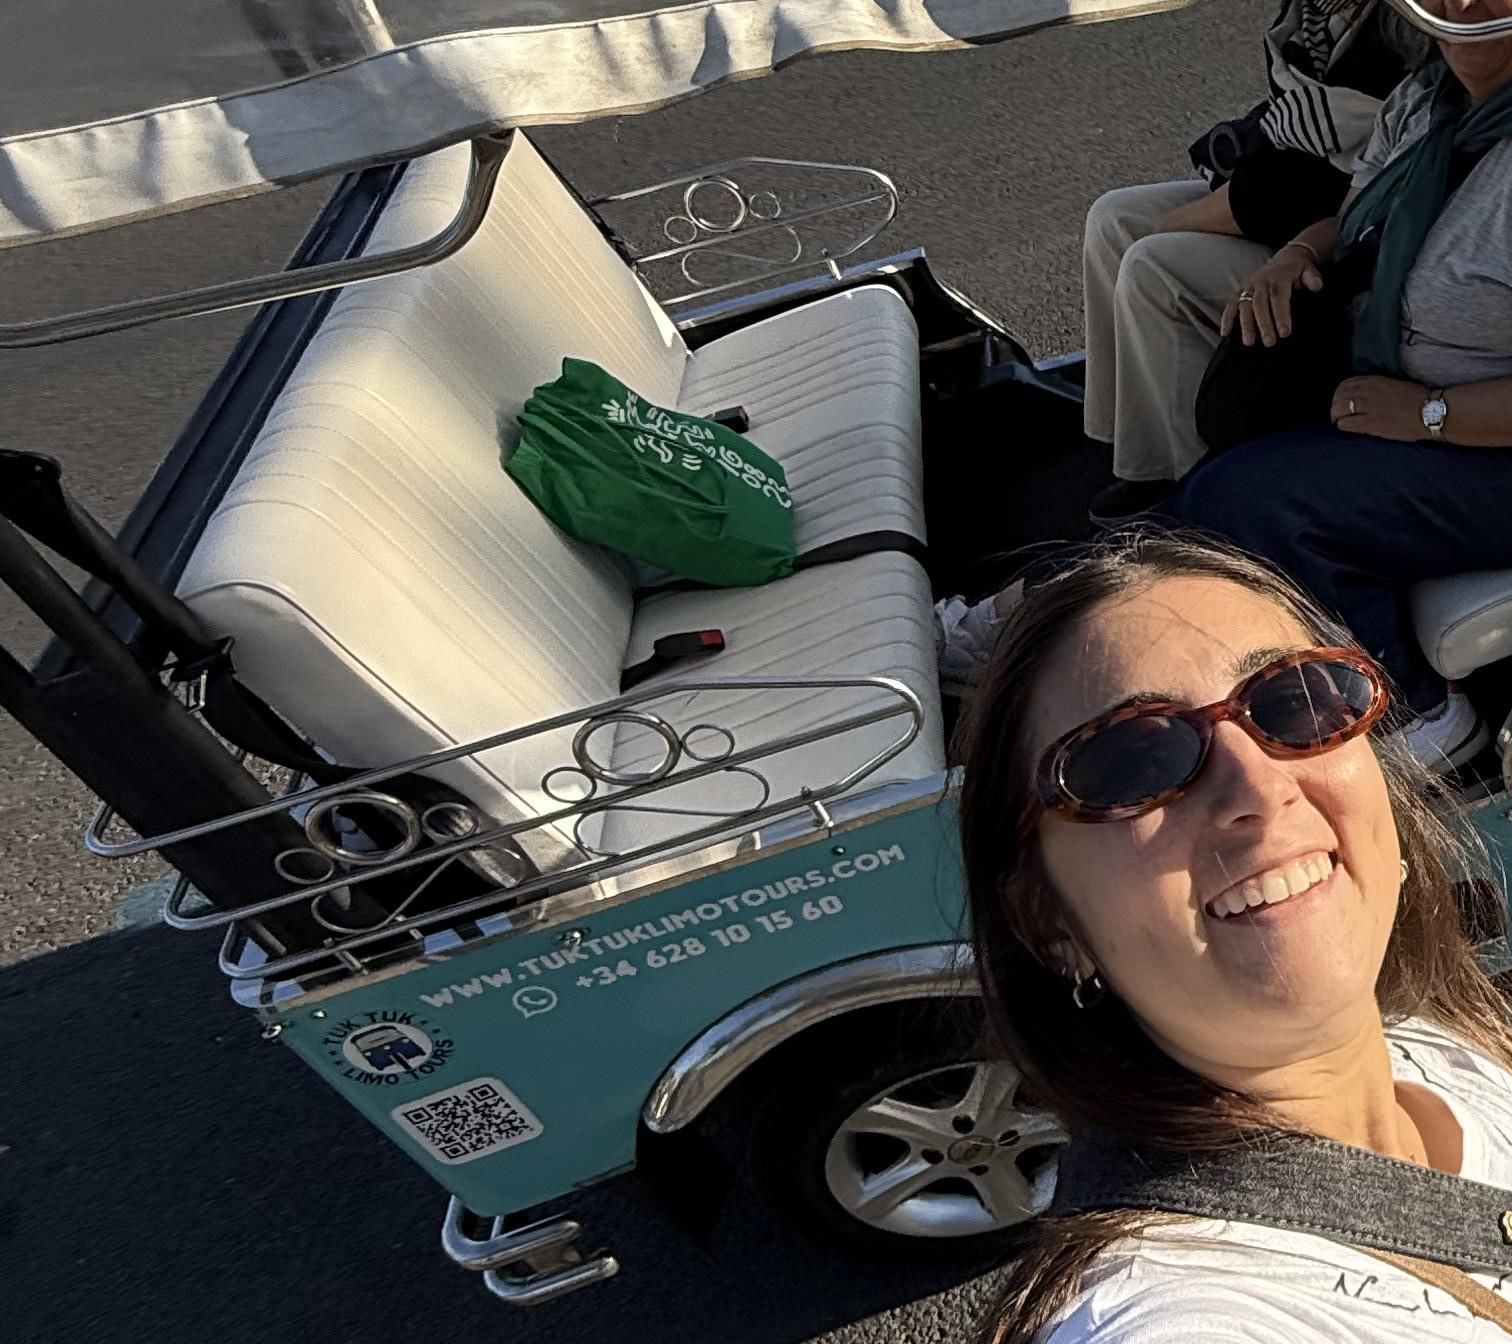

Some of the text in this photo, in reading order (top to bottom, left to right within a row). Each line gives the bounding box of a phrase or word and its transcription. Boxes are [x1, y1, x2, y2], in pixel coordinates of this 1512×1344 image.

[419, 844, 906, 1008] WWW.TUKTUKLIMOTOURS.COM
[576, 894, 845, 989] +34 628 10 15 60
[323, 1010, 417, 1045] TUK TUK
[343, 1038, 456, 1086] LIMO TOURS
